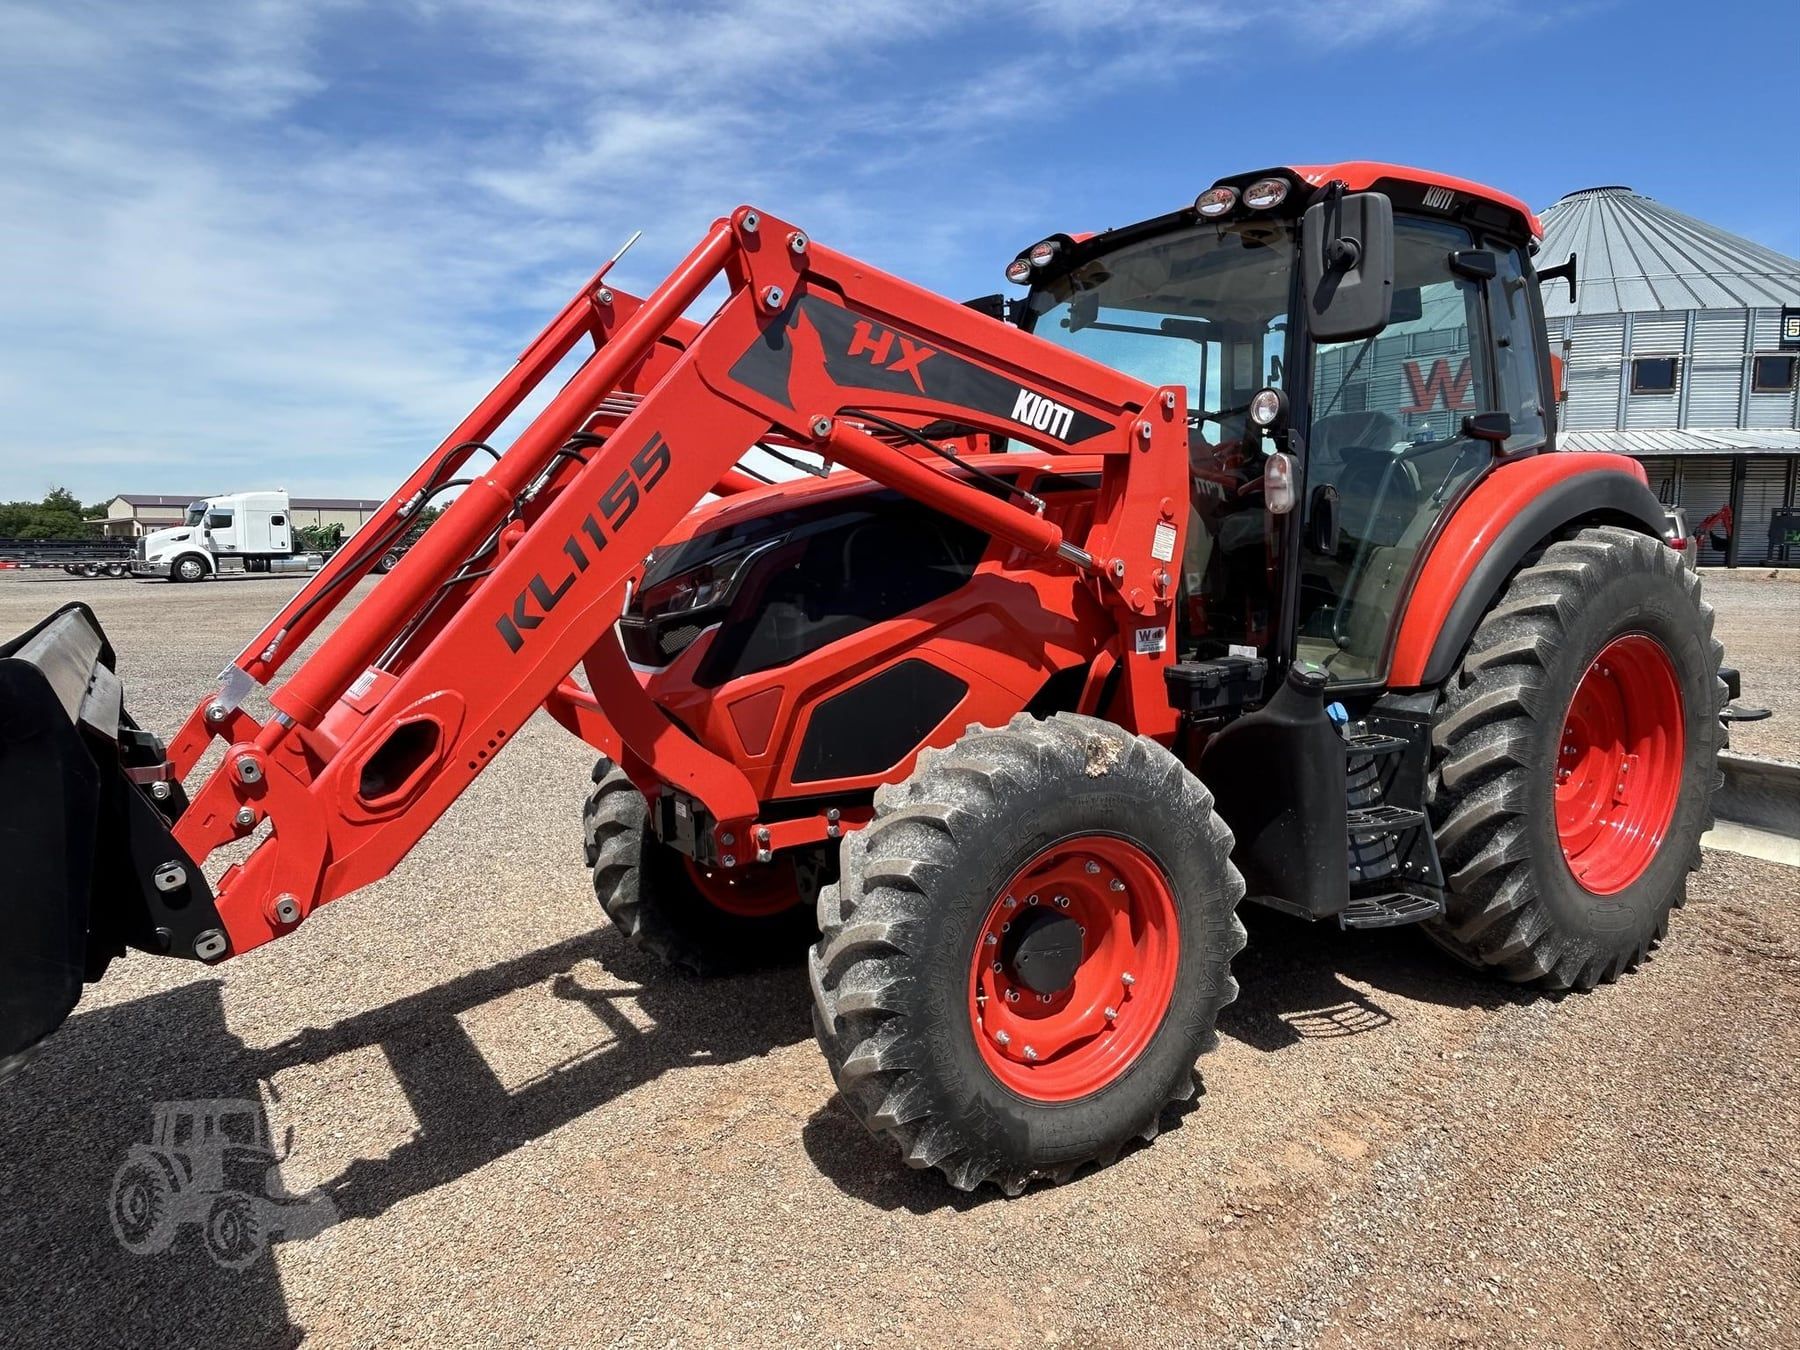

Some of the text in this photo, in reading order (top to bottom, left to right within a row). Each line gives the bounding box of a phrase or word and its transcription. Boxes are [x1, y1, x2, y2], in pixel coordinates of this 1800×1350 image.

[1422, 186, 1455, 210] KIOTI
[847, 320, 937, 393] HX
[1011, 388, 1075, 440] KIOTI
[495, 431, 671, 654] KL1155
